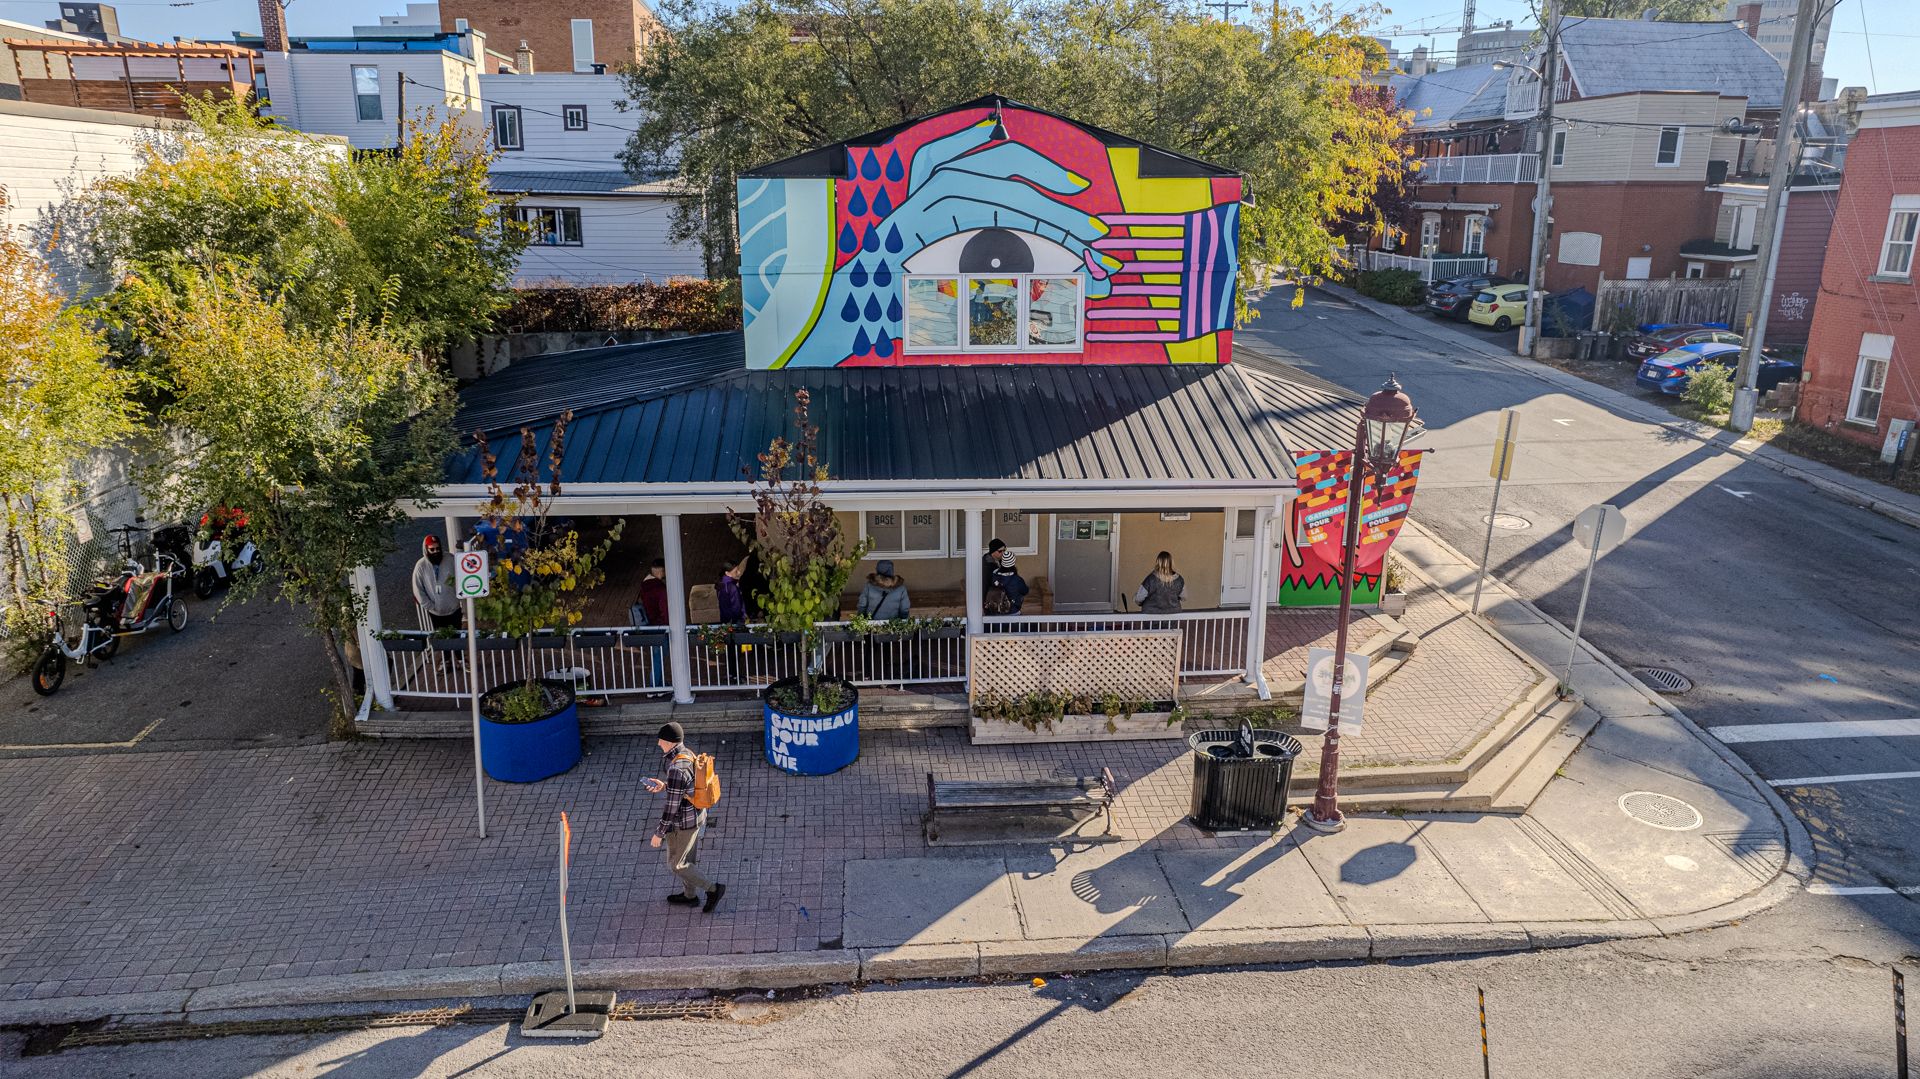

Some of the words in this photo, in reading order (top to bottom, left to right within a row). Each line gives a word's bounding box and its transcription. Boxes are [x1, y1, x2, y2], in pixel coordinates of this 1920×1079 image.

[1003, 512, 1023, 523] BASE
[1308, 504, 1344, 521] GATINEAU
[875, 514, 896, 525] BASE
[913, 514, 933, 525] BASE
[1309, 517, 1330, 529] POUR
[1369, 516, 1390, 528] POUR
[1312, 533, 1325, 542] VIE
[1371, 532, 1385, 540] VIE
[771, 710, 854, 732] GATINEAU
[771, 725, 819, 746] POUR
[771, 737, 790, 756] LA
[772, 750, 798, 772] VIE
